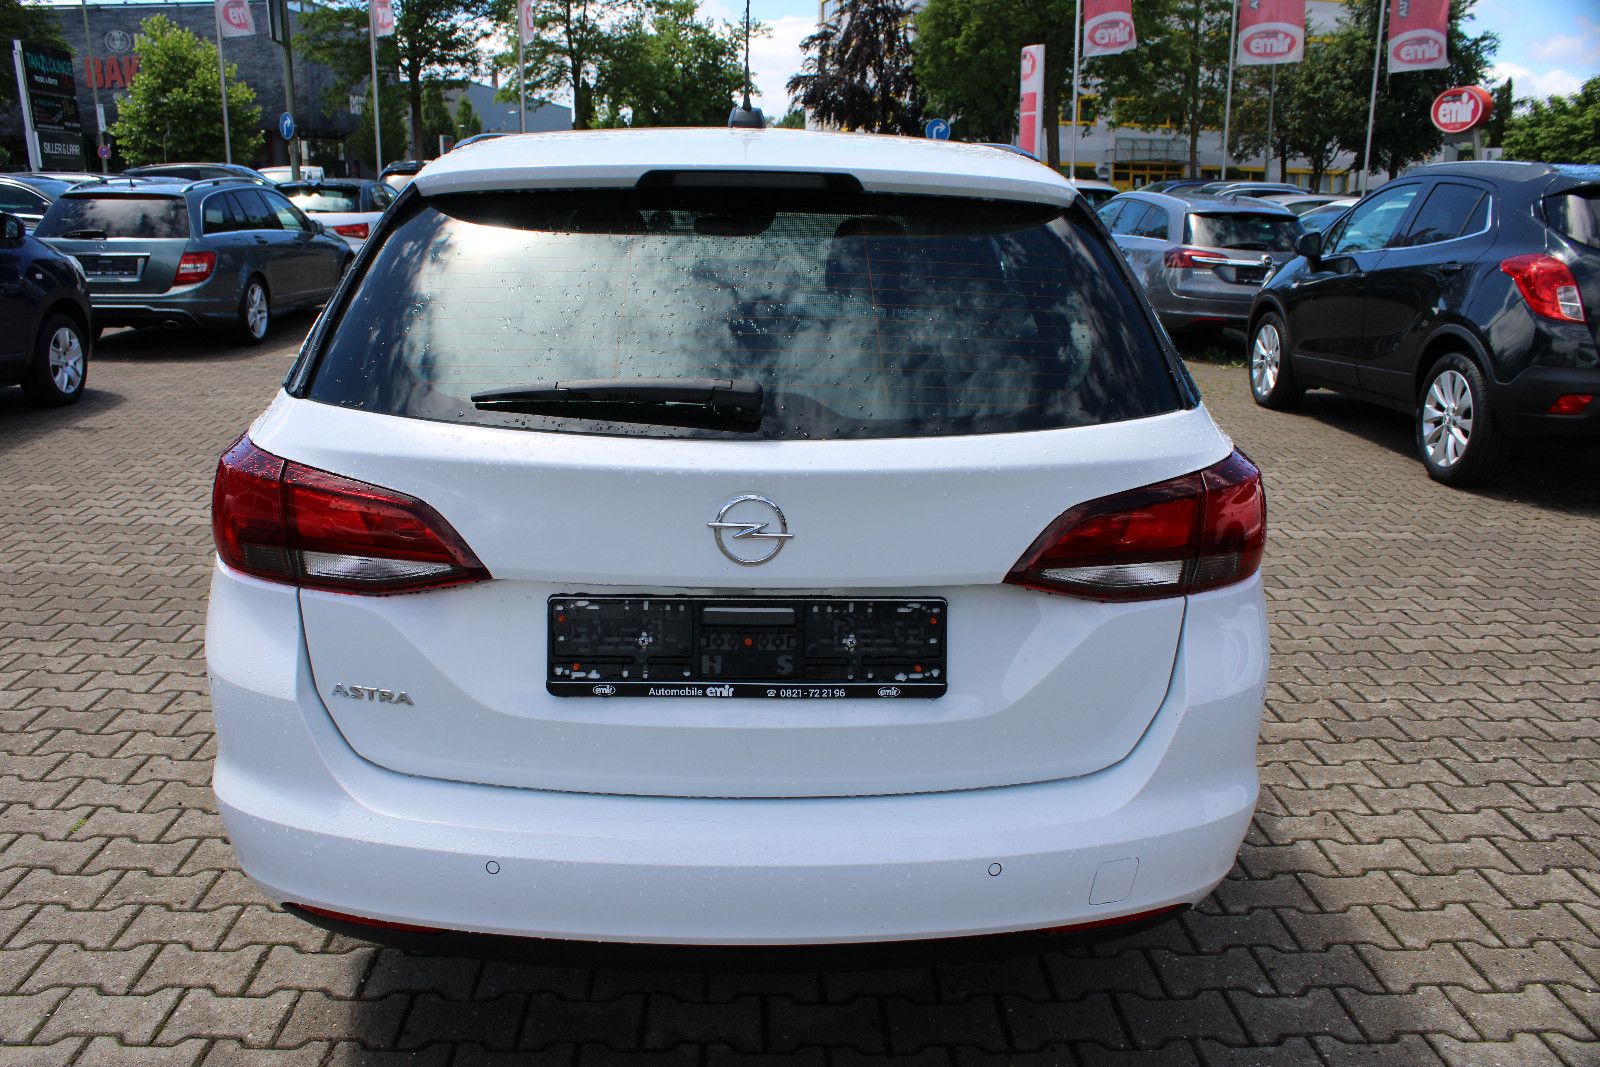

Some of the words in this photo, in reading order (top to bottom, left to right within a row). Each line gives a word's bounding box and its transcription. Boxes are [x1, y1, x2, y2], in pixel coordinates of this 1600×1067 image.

[1095, 22, 1130, 44] emir
[1250, 33, 1291, 53] emir
[1400, 40, 1440, 60] emir
[1438, 92, 1475, 124] emir
[332, 683, 415, 706] ASTRA
[595, 685, 613, 695] emir
[648, 687, 703, 697] Automobile
[706, 685, 735, 697] emir
[880, 687, 897, 696] emir
